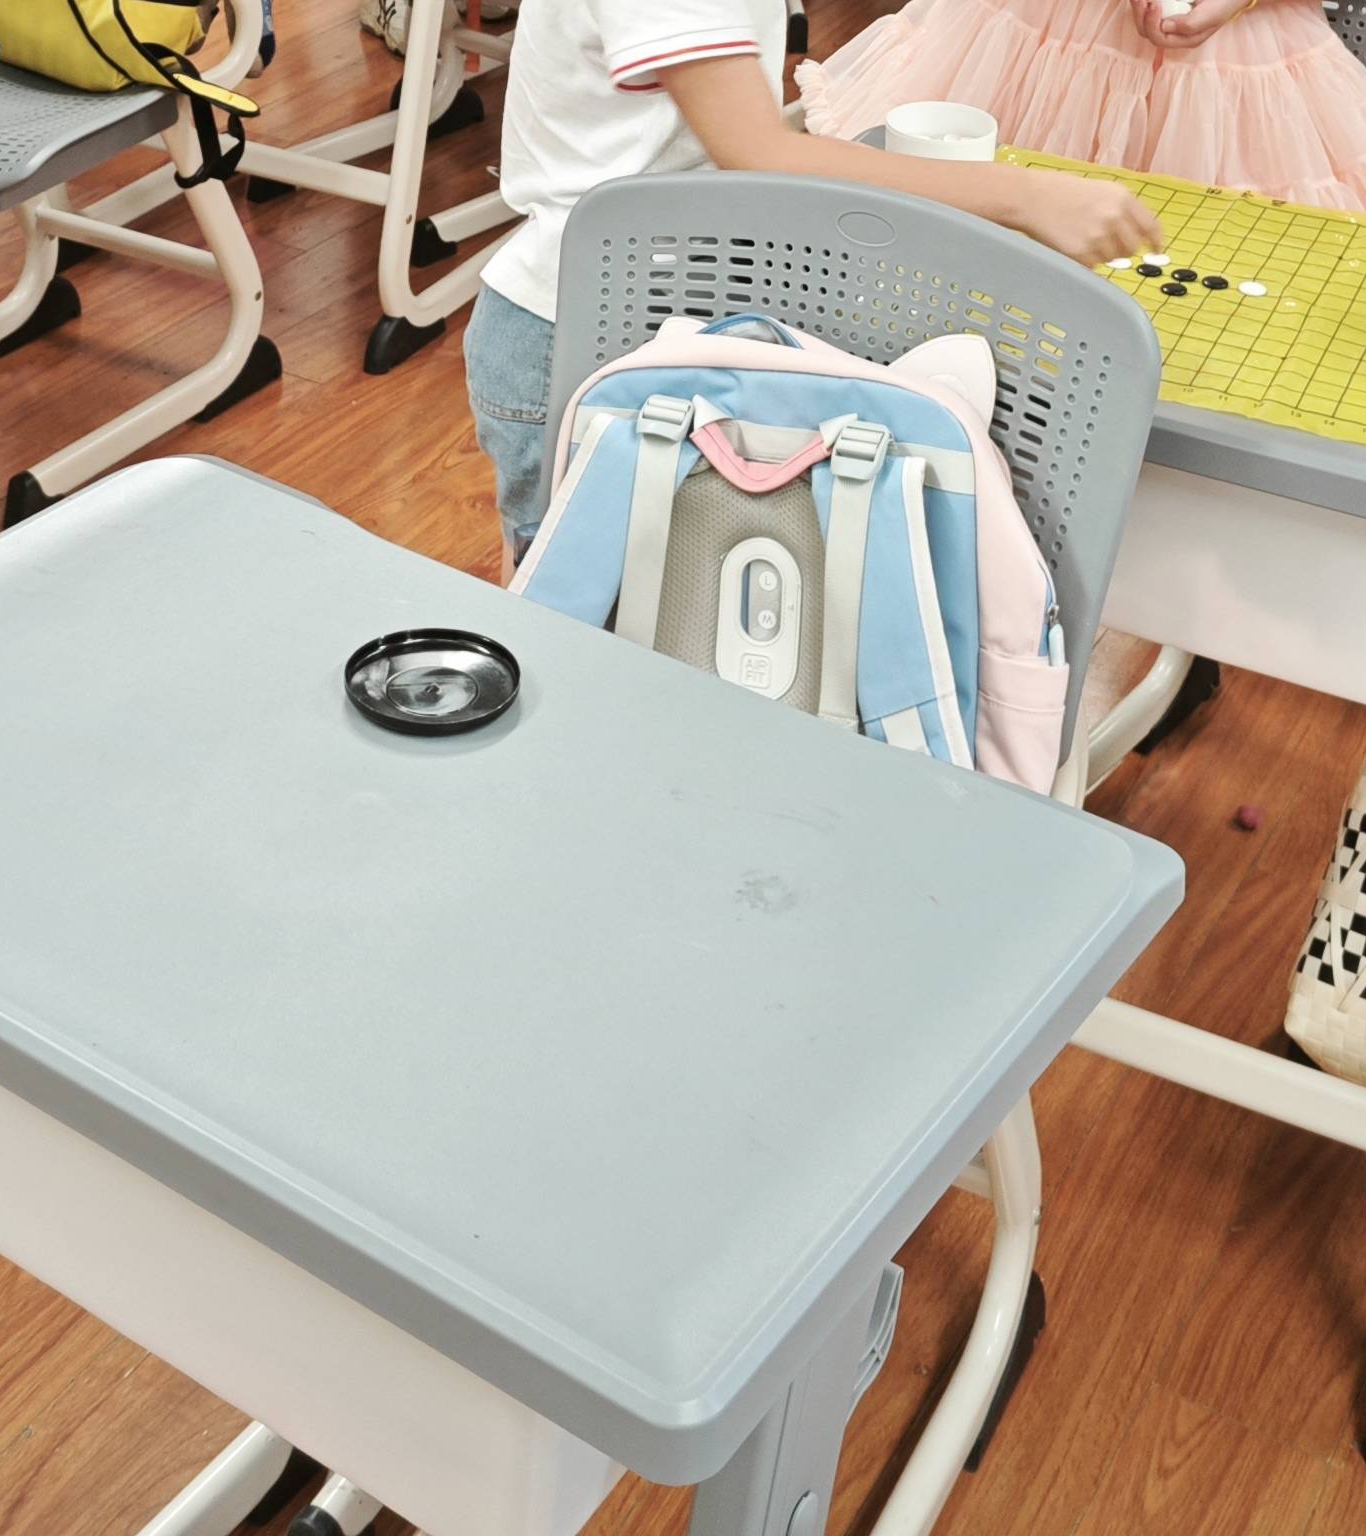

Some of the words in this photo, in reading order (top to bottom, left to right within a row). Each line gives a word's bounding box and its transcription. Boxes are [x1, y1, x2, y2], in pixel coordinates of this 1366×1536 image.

[764, 575, 772, 586] L
[763, 615, 773, 626] M
[746, 670, 766, 684] FIT
